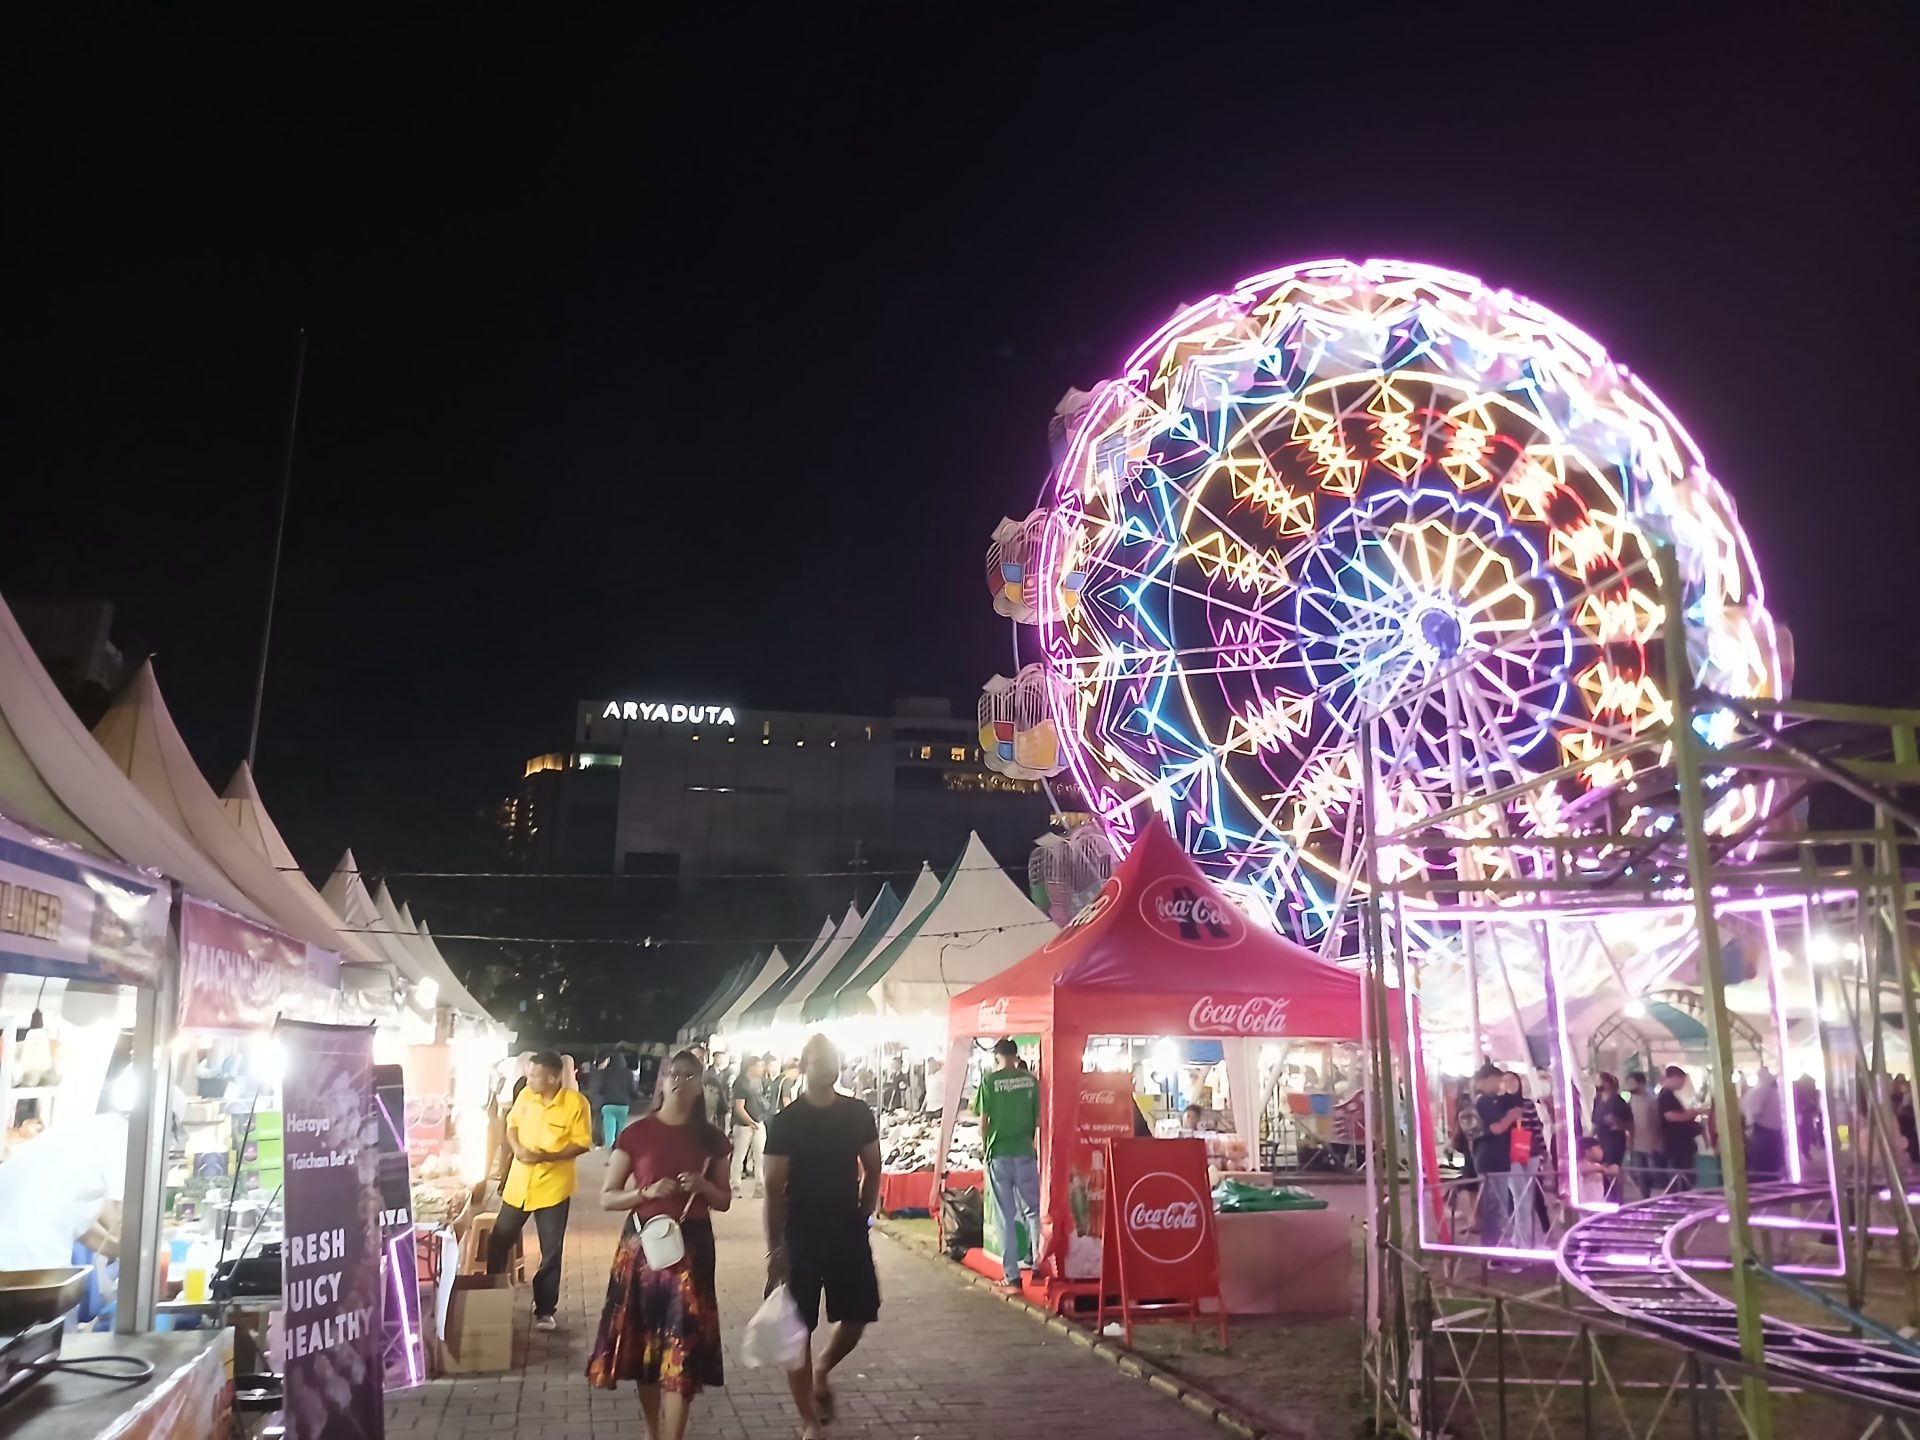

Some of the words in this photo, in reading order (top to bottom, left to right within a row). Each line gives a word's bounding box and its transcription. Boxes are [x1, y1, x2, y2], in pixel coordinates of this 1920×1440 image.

[602, 700, 736, 726] ARYADUTA
[0, 879, 62, 942] LINER
[1188, 995, 1291, 1032] Coca-Cola
[286, 1112, 331, 1137] Heraya
[1129, 1201, 1198, 1230] Coca-Cola
[280, 1227, 345, 1267] FRESH
[284, 1305, 374, 1360] HEALTHY
